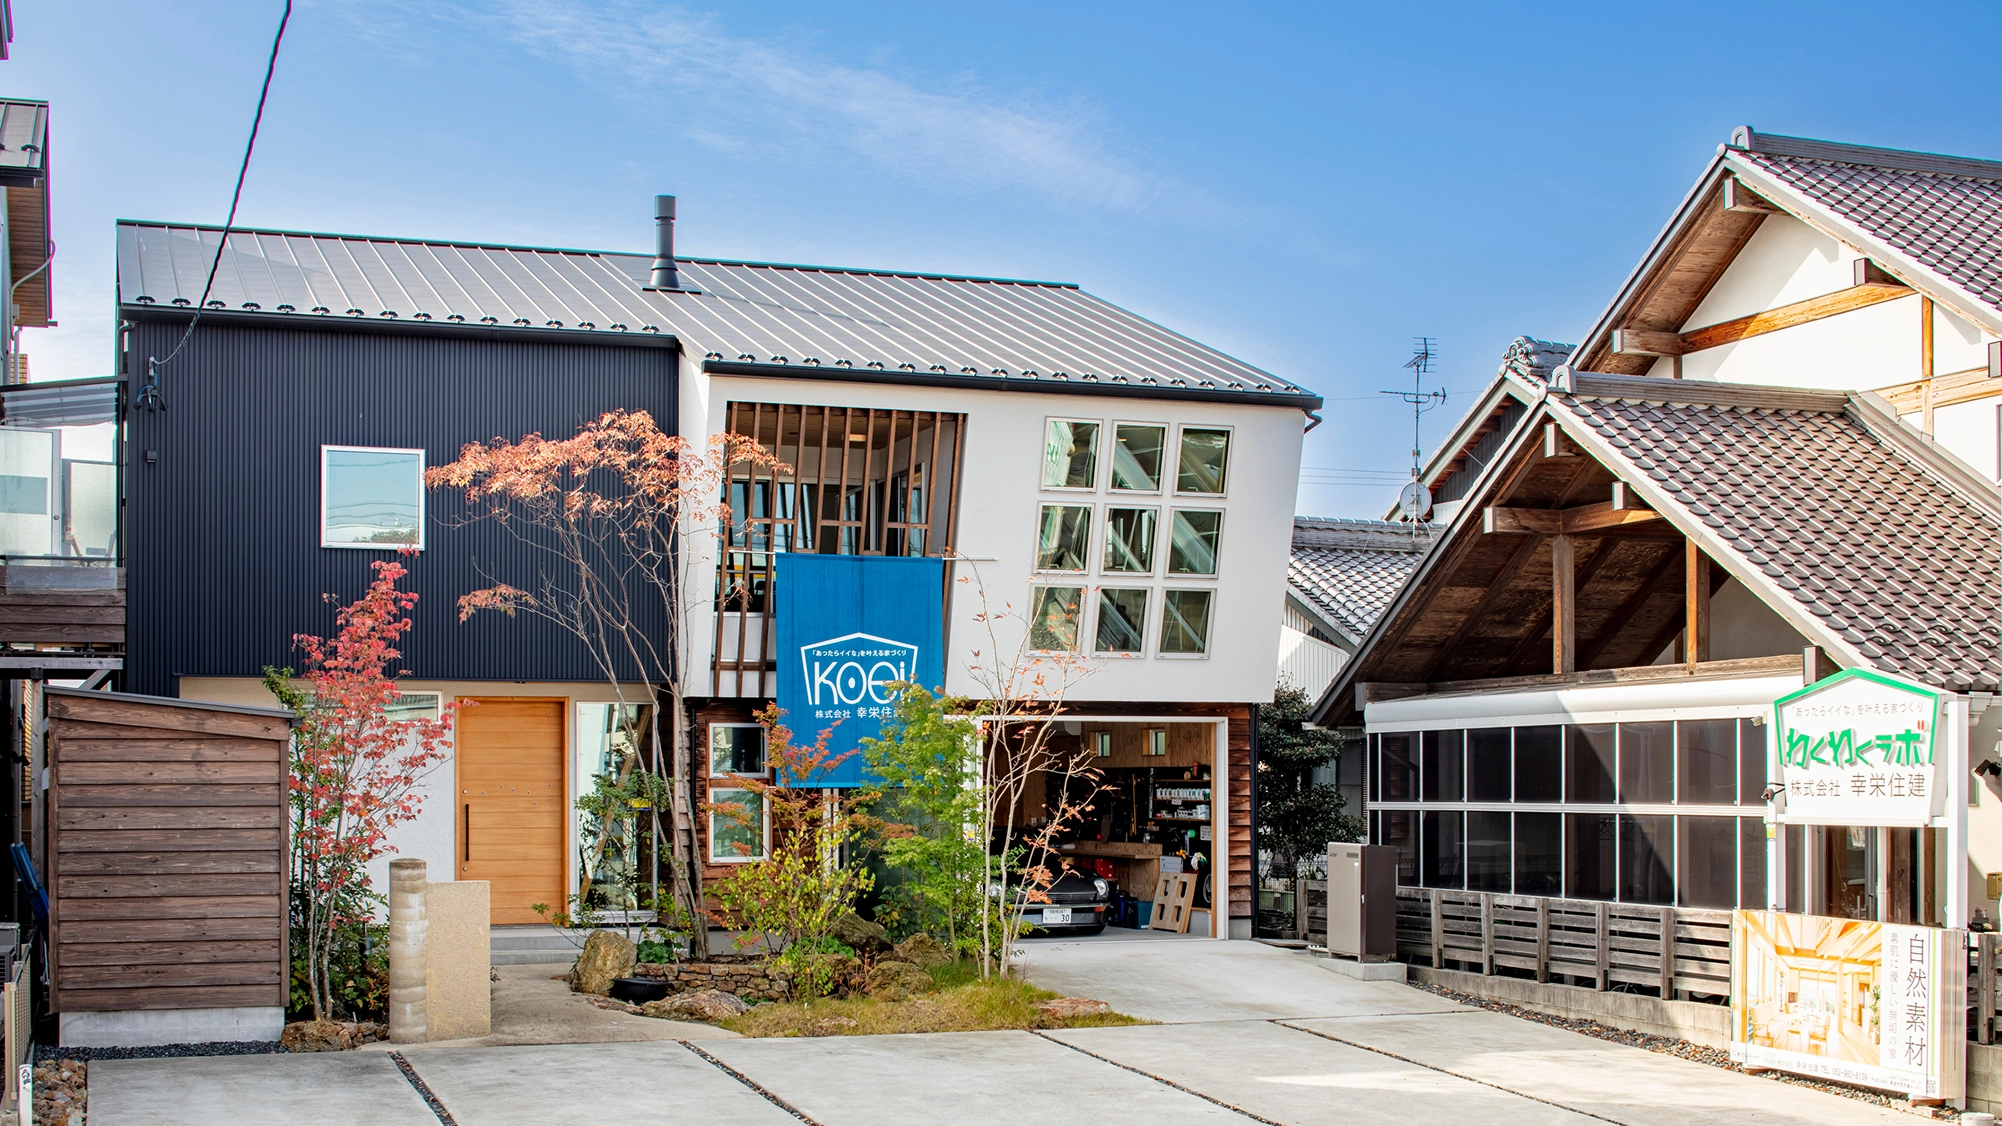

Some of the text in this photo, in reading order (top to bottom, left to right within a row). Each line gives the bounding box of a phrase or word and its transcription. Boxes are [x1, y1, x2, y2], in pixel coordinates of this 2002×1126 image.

[812, 649, 907, 657] 「あったらイイな」を叶える家づくり
[815, 709, 851, 719] 株式会社
[1791, 701, 1924, 717] 「あったらイイな」を叶える家づくり
[1786, 719, 1926, 767] わくわくラボ
[1790, 772, 1926, 798] 株式会社 幸栄住建
[1903, 933, 1927, 1067] 自然素材
[1820, 1065, 1830, 1075] TEL
